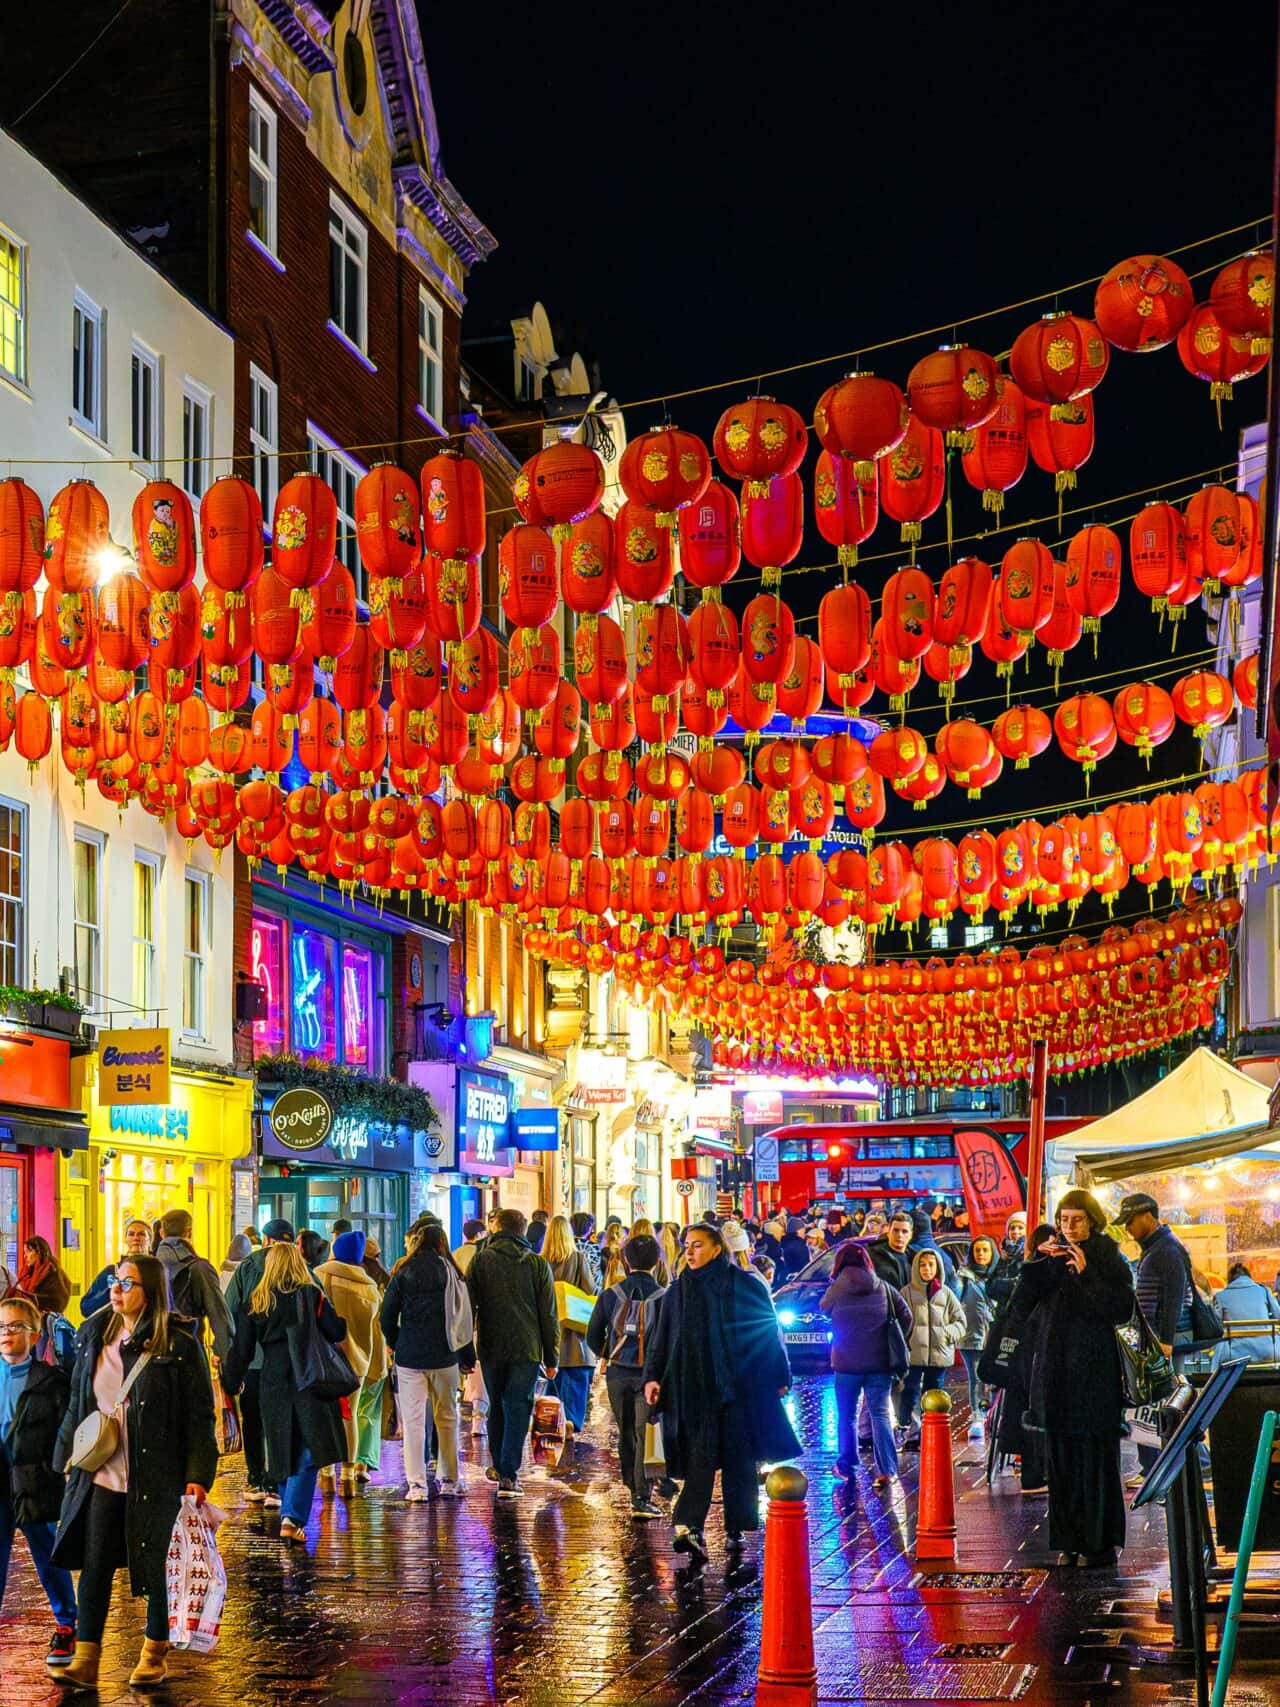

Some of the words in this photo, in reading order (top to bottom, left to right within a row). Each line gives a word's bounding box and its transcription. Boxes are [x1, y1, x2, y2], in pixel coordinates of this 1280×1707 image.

[117, 1073, 151, 1092] 분식
[466, 1087, 508, 1124] BETFRED
[679, 1183, 692, 1192] 20
